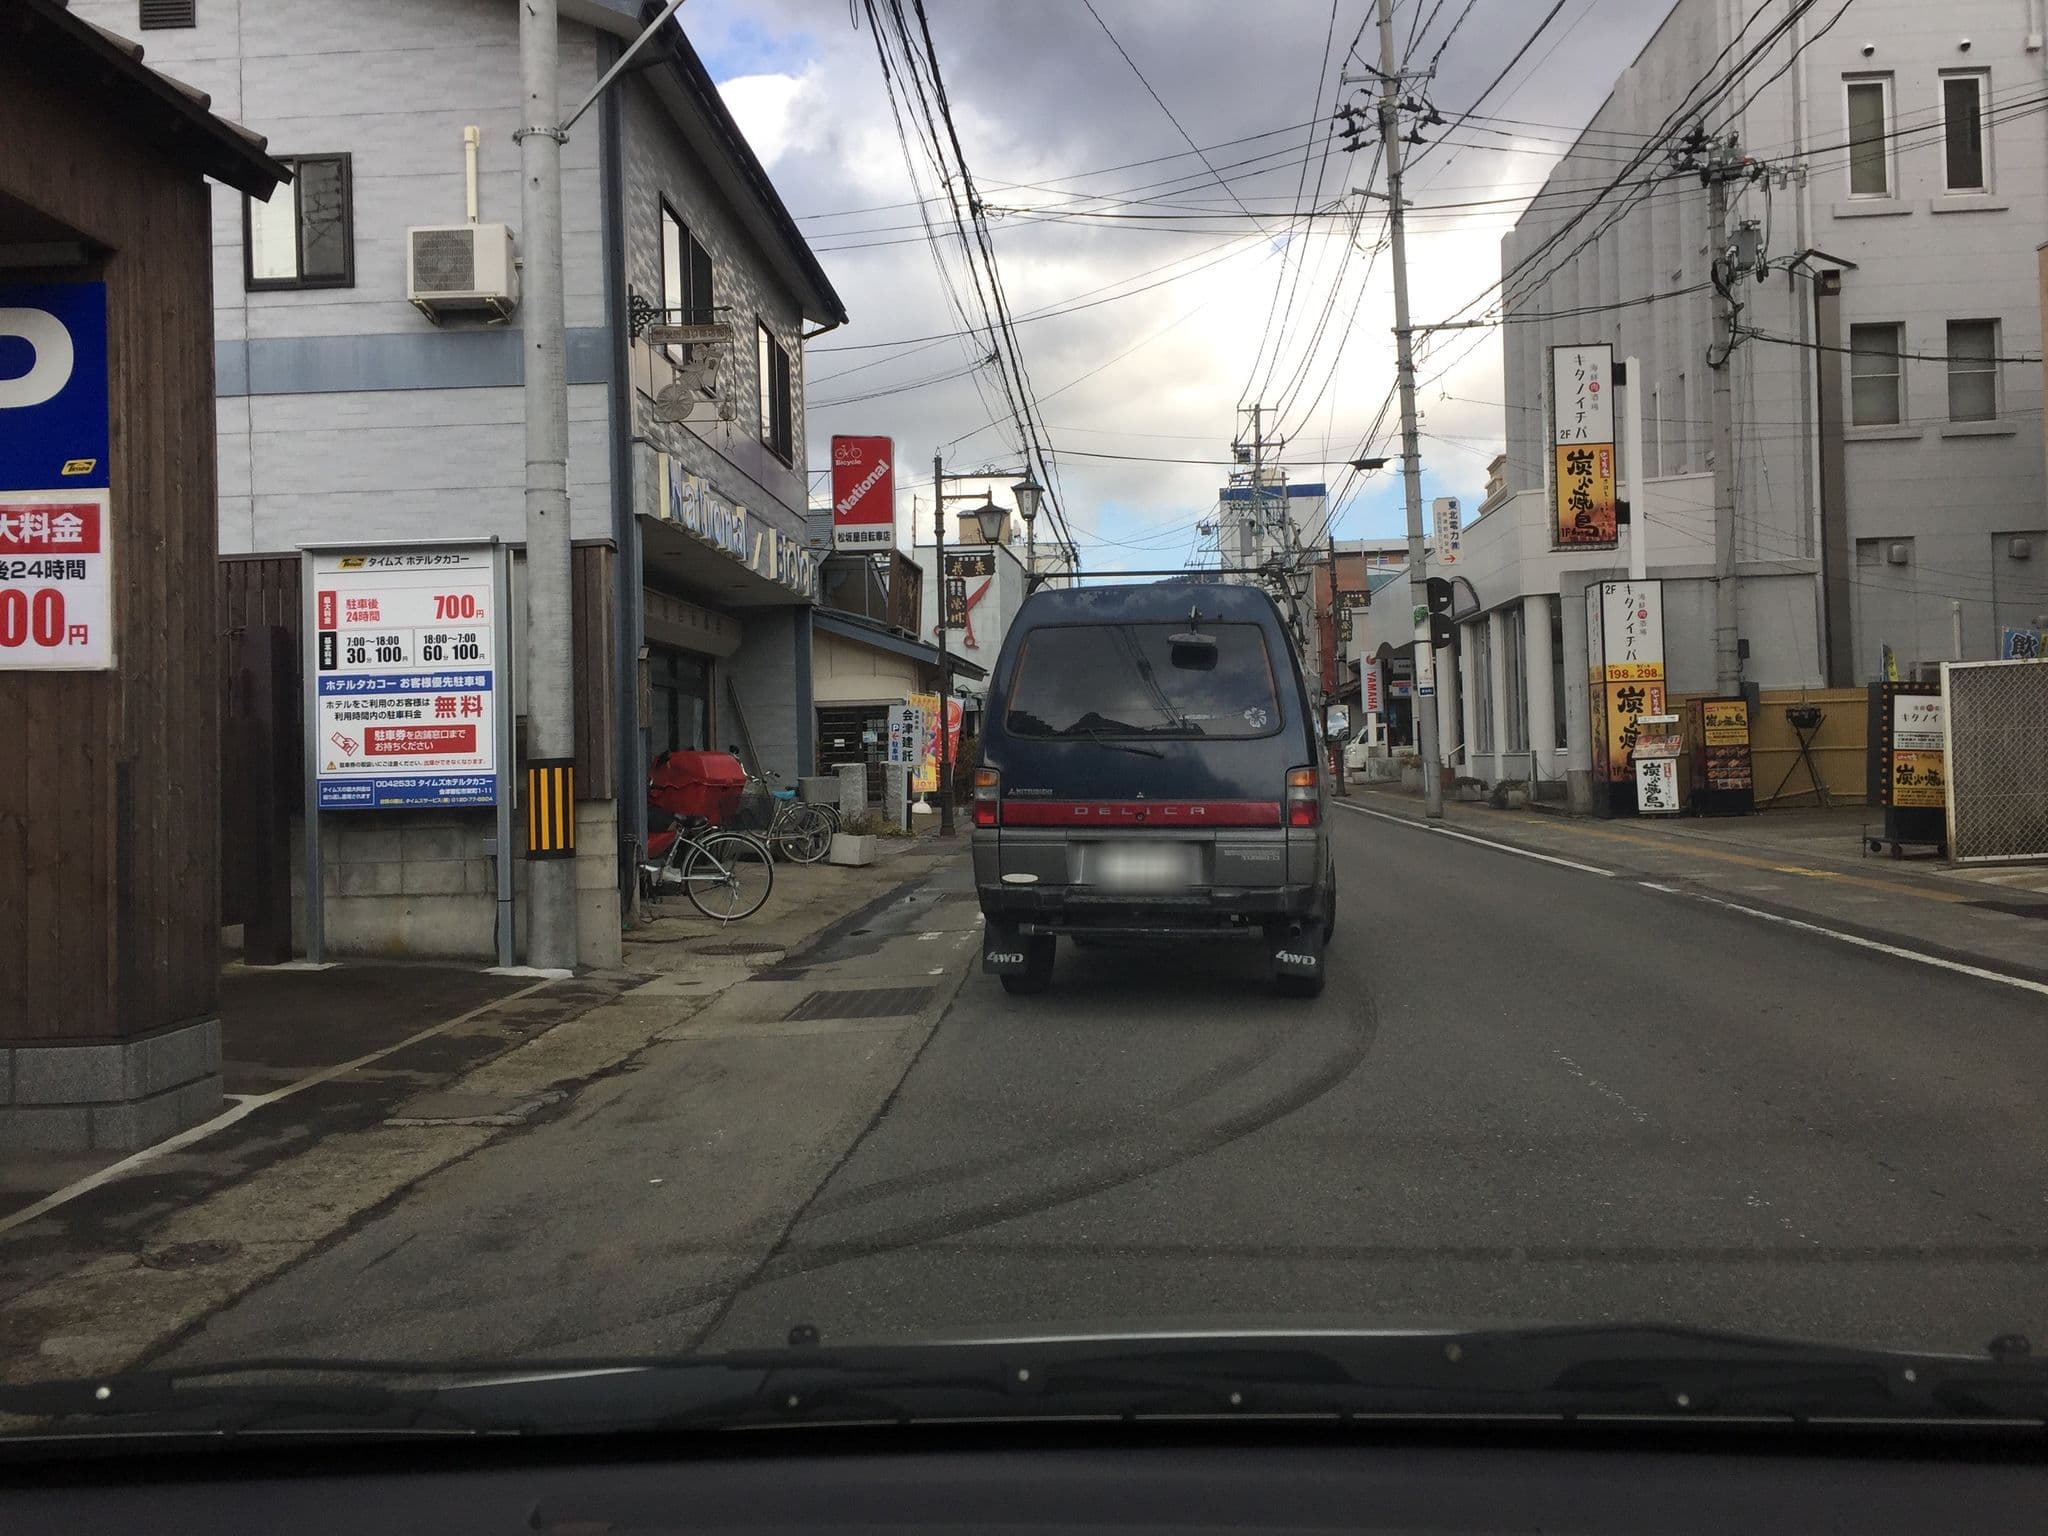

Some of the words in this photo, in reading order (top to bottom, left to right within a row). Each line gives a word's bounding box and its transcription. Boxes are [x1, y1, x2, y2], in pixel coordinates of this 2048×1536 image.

[1574, 354, 1587, 438] キタノイチバ
[1560, 430, 1571, 439] 2F
[837, 458, 890, 516] National
[1567, 449, 1599, 537] 炭火焼鳥
[838, 531, 891, 543] 松坂屋自転車店
[369, 557, 403, 567] タイムズ
[406, 554, 469, 566] ホテルタカコー
[1605, 584, 1616, 595] 2F
[346, 598, 379, 610] 駐車後
[346, 611, 381, 623] 24時間
[325, 680, 397, 691] ホテルタカコー
[399, 675, 486, 689] お客様優先駐車場
[1367, 672, 1378, 710] YAMAHA
[434, 694, 483, 718] 無料
[902, 709, 914, 762] 会津建託
[374, 741, 434, 752] お持ちください
[1643, 763, 1664, 808] 炭火焼鳥
[1074, 806, 1205, 816] DELICA
[986, 951, 1024, 963] 4WD
[1276, 950, 1316, 966] 4WD
